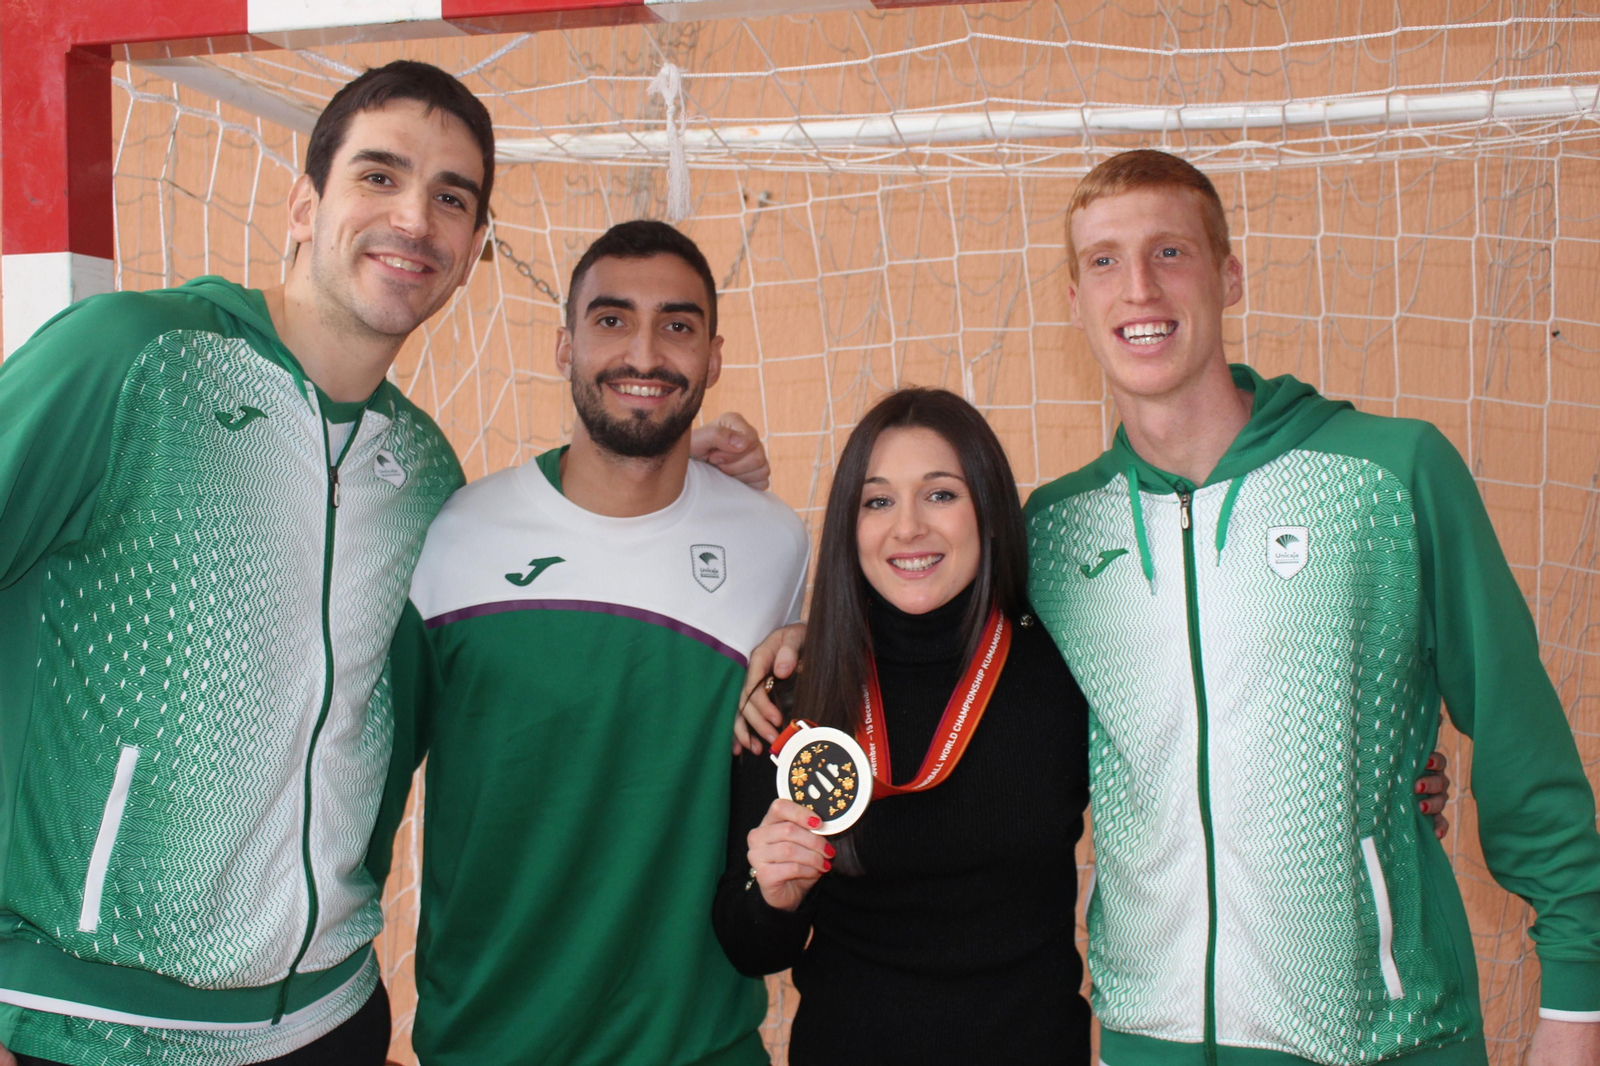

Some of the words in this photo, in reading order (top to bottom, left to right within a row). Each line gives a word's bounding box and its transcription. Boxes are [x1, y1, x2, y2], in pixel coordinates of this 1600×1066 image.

[862, 684, 873, 724] December
[939, 732, 958, 761] WORLD
[953, 669, 985, 731] CHAMPIONSHIP
[866, 724, 874, 735] 15
[869, 743, 878, 777] ovember
